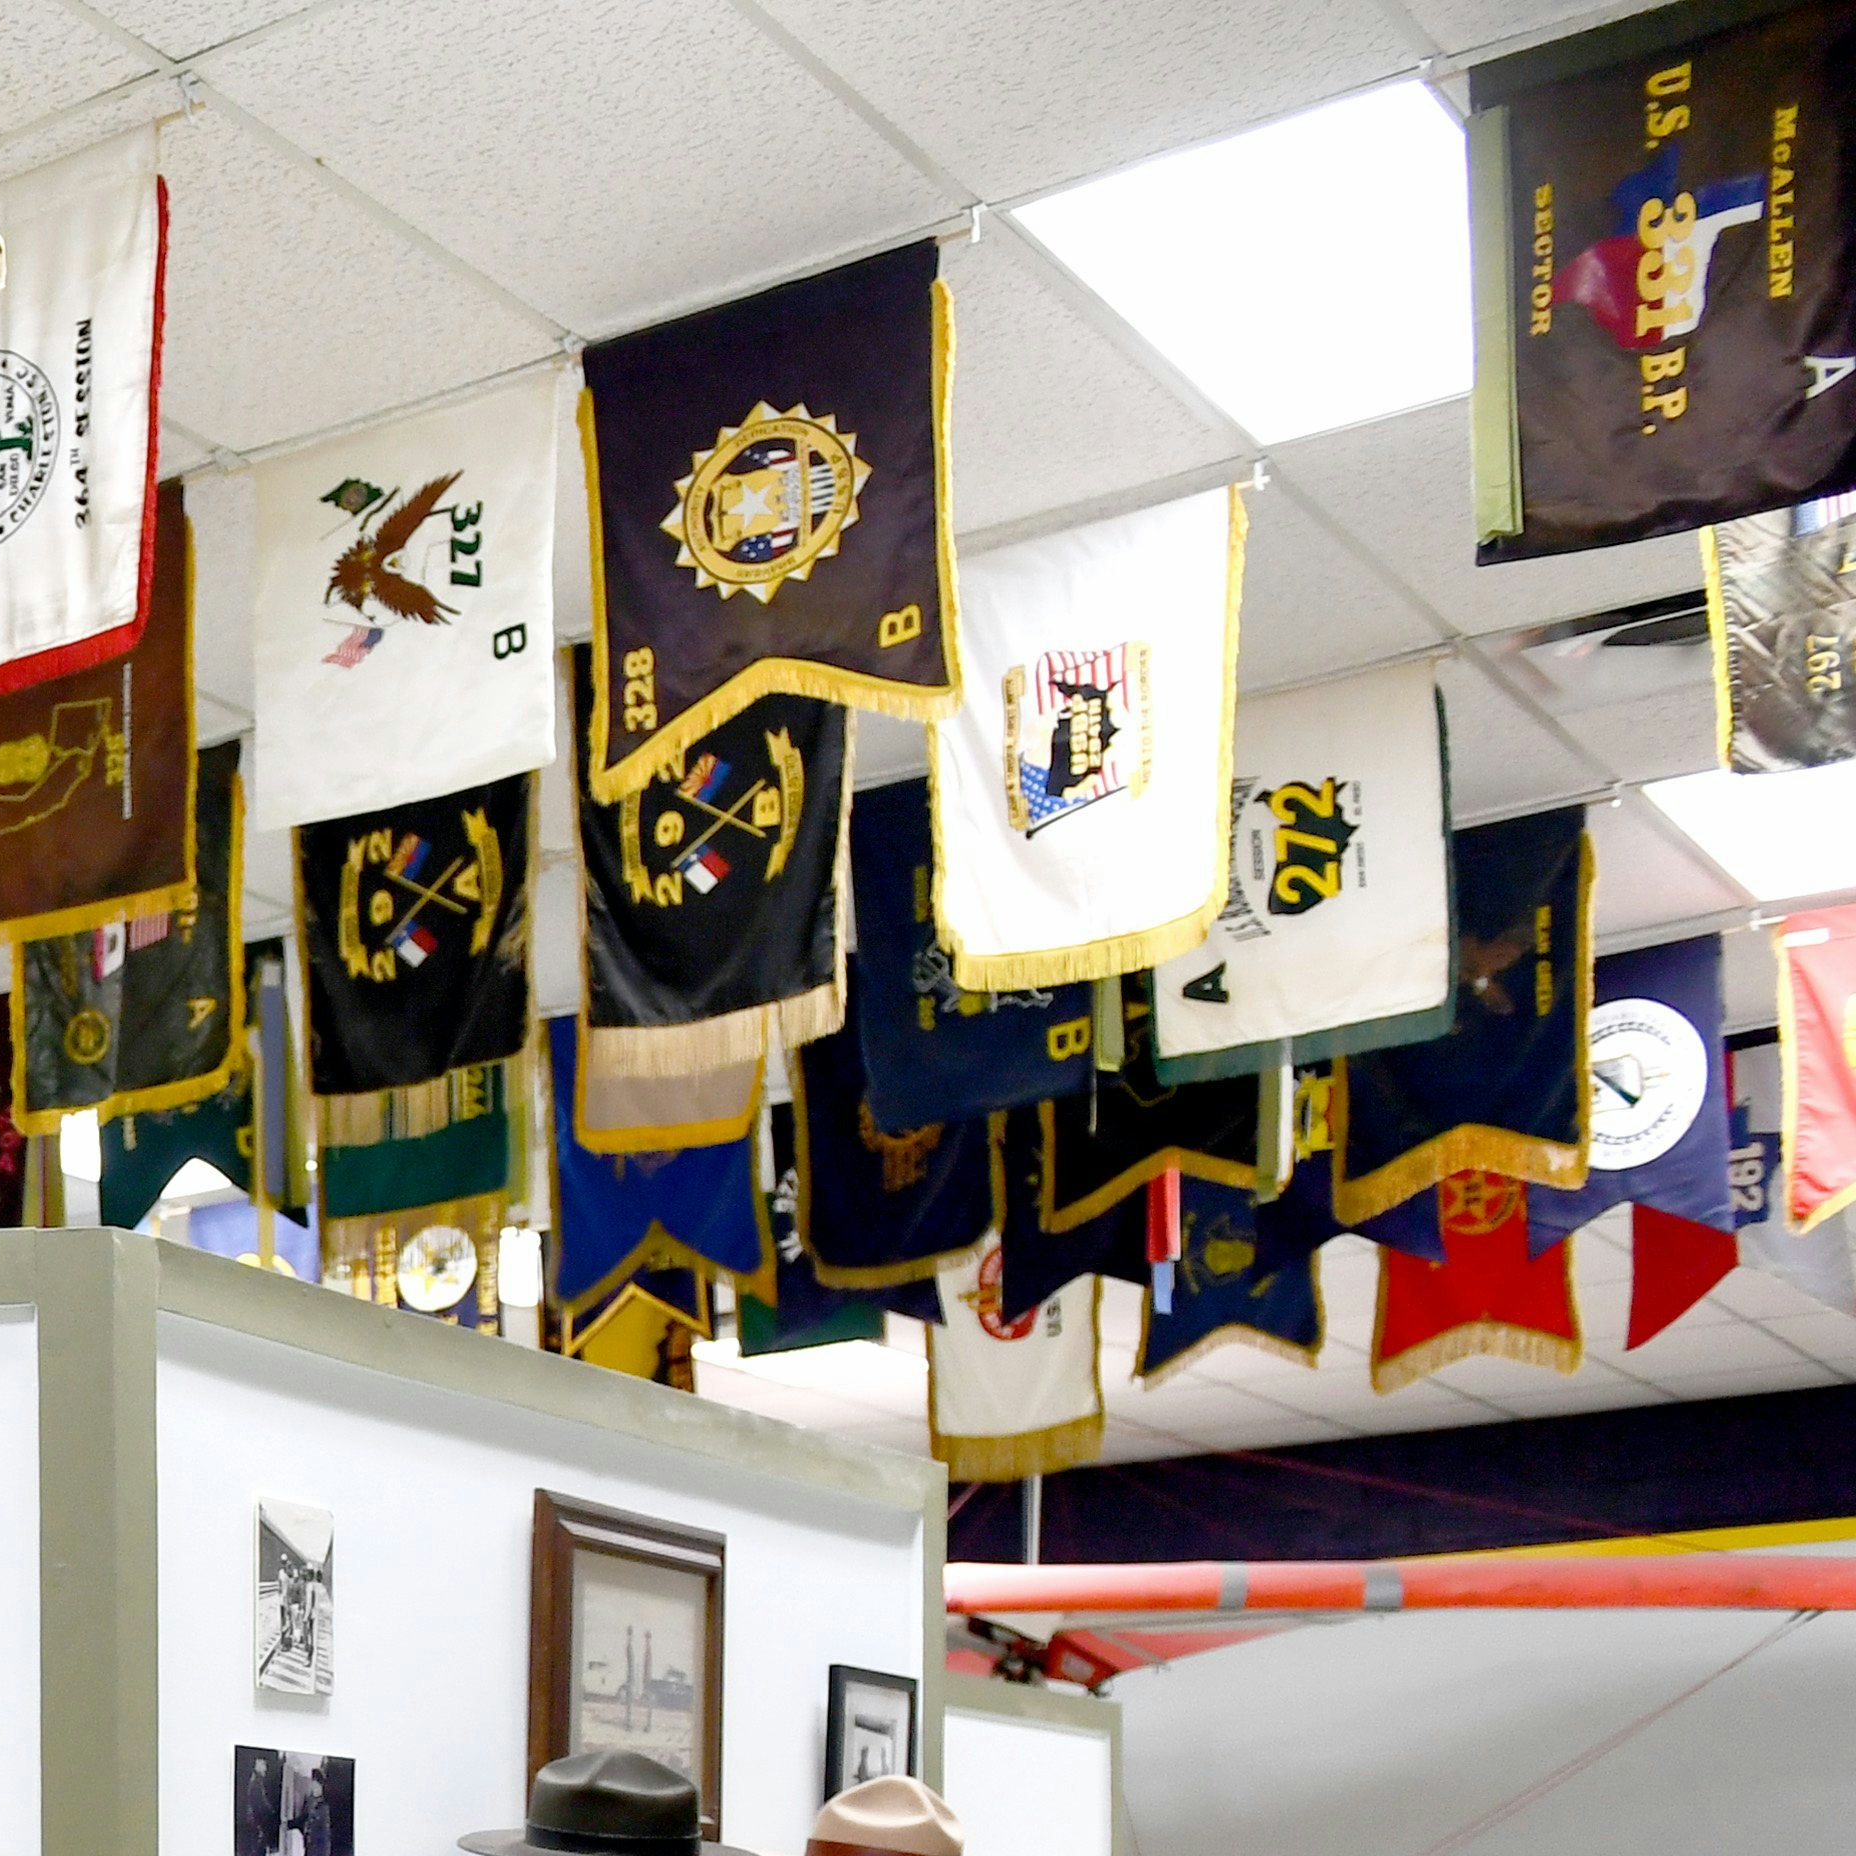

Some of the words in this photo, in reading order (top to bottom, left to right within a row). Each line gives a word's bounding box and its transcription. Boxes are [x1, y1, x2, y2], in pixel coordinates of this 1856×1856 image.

[1644, 60, 1693, 150] U.S.
[1768, 103, 1799, 300] McALLEN
[1528, 181, 1553, 338] SECTOR
[1636, 190, 1697, 340] 331
[3, 384, 16, 424] YUMA
[74, 317, 94, 438] SESSION
[1640, 352, 1689, 436] B.P.
[1803, 355, 1856, 400] A
[450, 499, 483, 589] 327
[492, 621, 529, 662] B
[877, 603, 923, 649] B
[622, 646, 659, 732] 328
[1806, 631, 1843, 696] 297
[1069, 692, 1089, 776] USBP
[751, 785, 783, 828] B
[1269, 779, 1341, 904] 272
[1250, 828, 1265, 881] SESSION
[188, 996, 217, 1030] A
[1182, 959, 1231, 1003] A
[1046, 1015, 1090, 1062] B
[1731, 1139, 1764, 1213] 192
